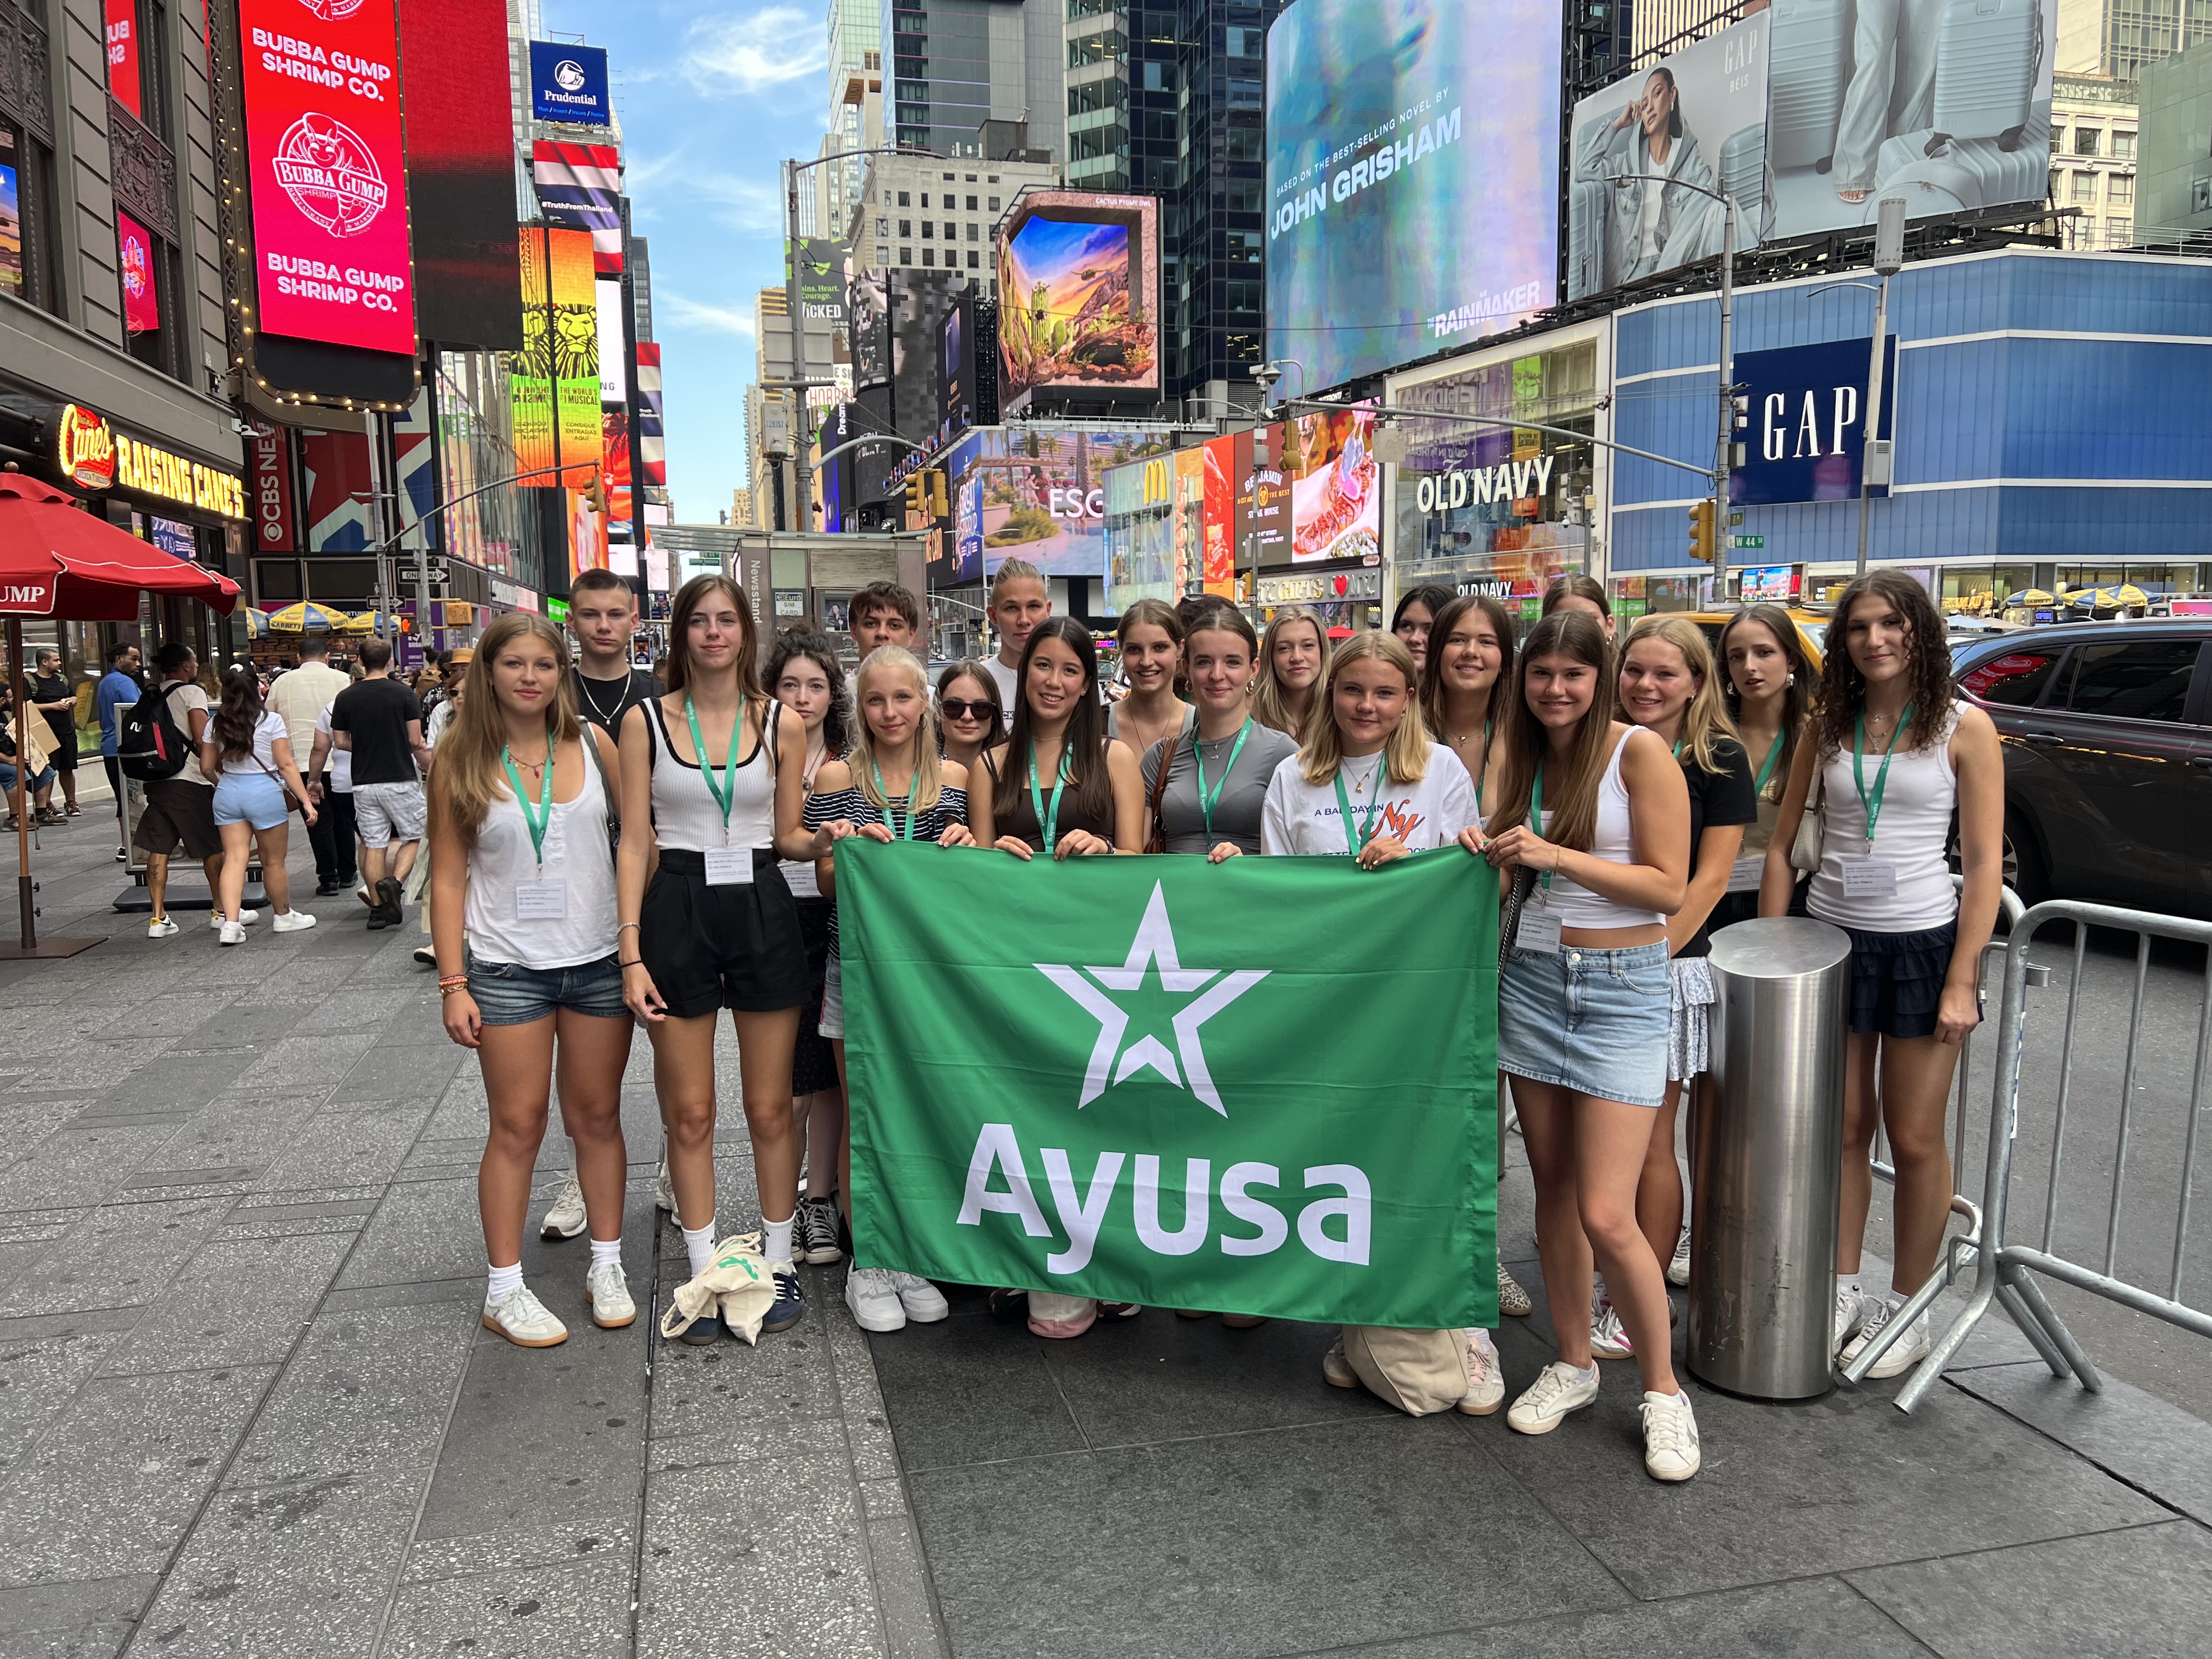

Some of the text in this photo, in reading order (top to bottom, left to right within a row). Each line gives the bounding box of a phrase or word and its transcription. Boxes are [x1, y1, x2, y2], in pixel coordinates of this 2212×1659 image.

[252, 27, 391, 81] BUBBA GUMP
[1725, 30, 1757, 75] GAP
[262, 52, 384, 101] SHRIMP CO.
[1730, 74, 1749, 93] BÉIS
[544, 89, 597, 105] Prudential
[1276, 86, 1449, 198] BASED ON THE BEST-SELLING NOVEL BY
[279, 162, 384, 202] BUBBA GUMP
[1271, 106, 1462, 240] JOHN GRISHAM
[298, 188, 336, 200] SHRIMP
[541, 201, 613, 212] #TruthFromThailand
[268, 252, 404, 292] BUBBA GUMP
[278, 276, 398, 312] SHRIMP CO.
[1435, 280, 1541, 338] RAINMAKER
[568, 394, 599, 405] MUSICAL
[573, 387, 597, 396] WORLD'S
[837, 403, 847, 435] Dream
[1763, 386, 1857, 460] GAP
[59, 404, 114, 476] Cane's
[116, 433, 245, 519] RAISING CANE'S
[1417, 455, 1555, 513] OLD NAVY
[260, 475, 281, 522] CBS
[960, 477, 976, 516] GREAT
[1248, 506, 1279, 519] STAK HOUSE
[1736, 537, 1743, 547] W
[1746, 537, 1755, 547] 44
[751, 560, 763, 623] Newsstand
[784, 593, 802, 601] Euro
[1278, 578, 1324, 601] GIFTS
[1348, 572, 1376, 597] NY
[1458, 581, 1512, 597] OLD NAVY
[1374, 803, 1384, 813] IN
[956, 1122, 1372, 1274] Ayusa
